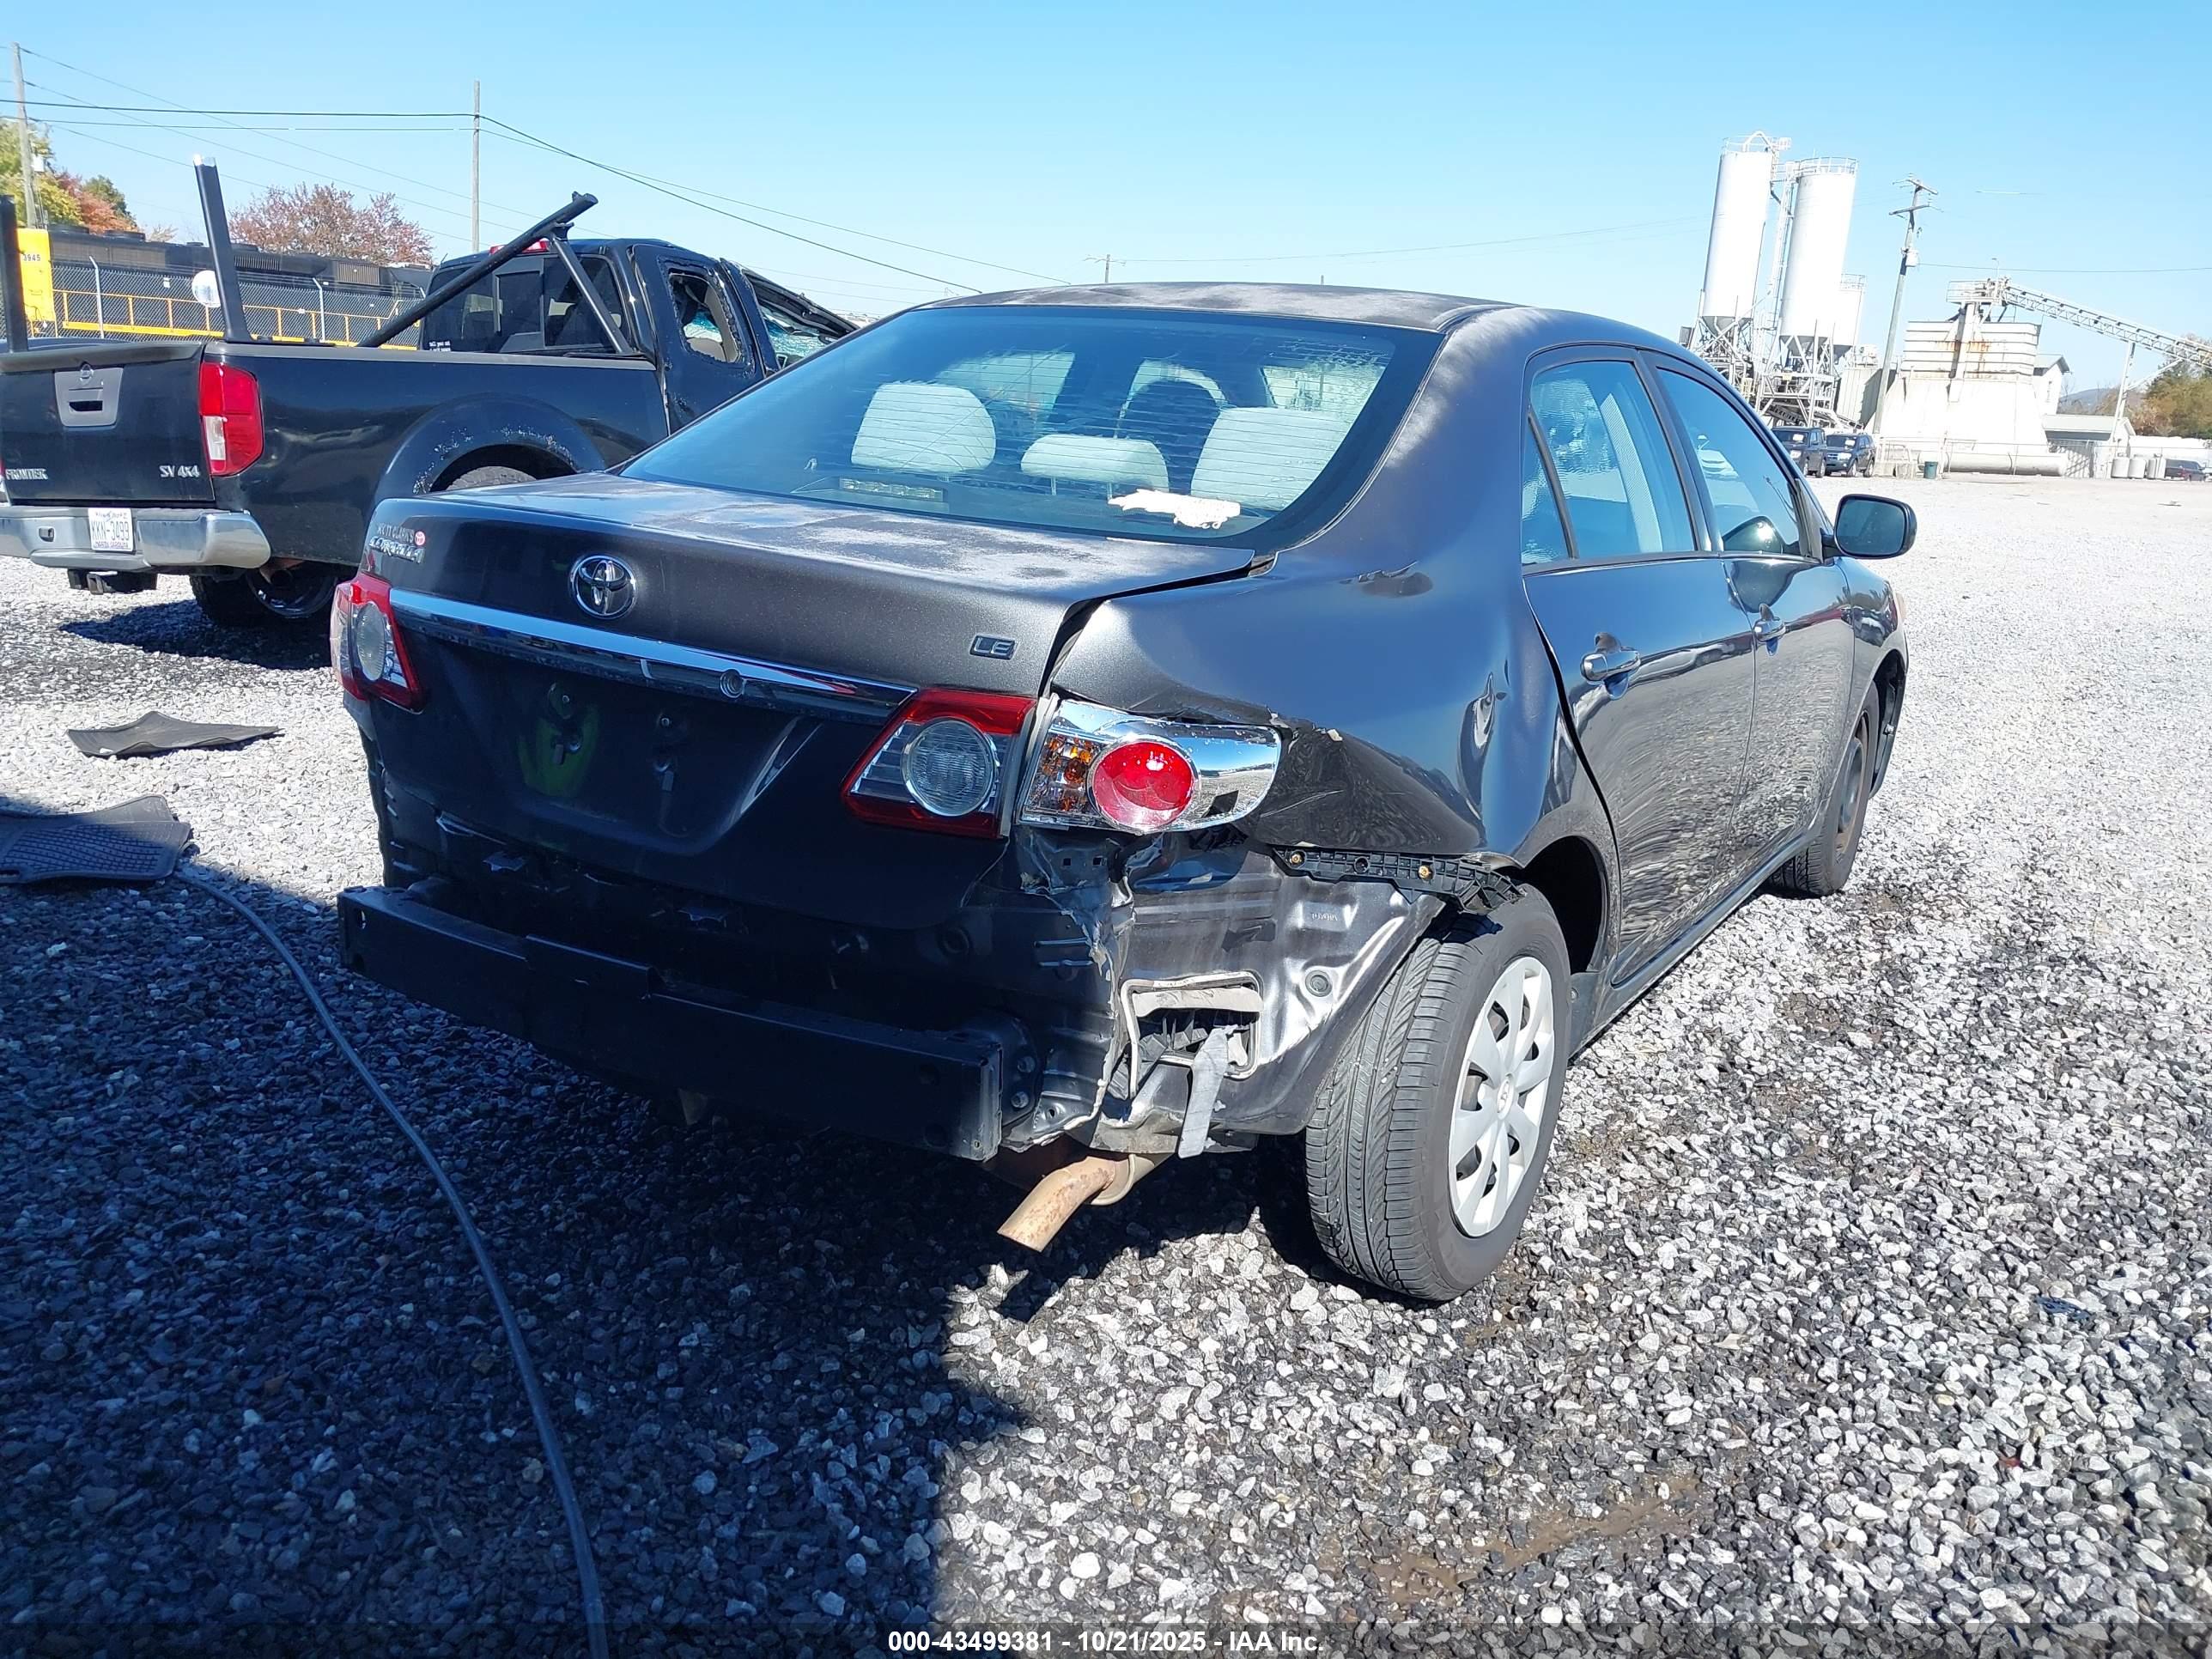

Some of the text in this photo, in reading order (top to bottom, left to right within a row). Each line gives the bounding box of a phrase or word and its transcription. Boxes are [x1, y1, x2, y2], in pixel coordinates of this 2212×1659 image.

[5, 468, 49, 480] FRONTIER
[159, 465, 175, 477] SV
[91, 520, 130, 541] KKN-3499
[369, 536, 424, 563] COROLLA
[974, 637, 1012, 656] LE
